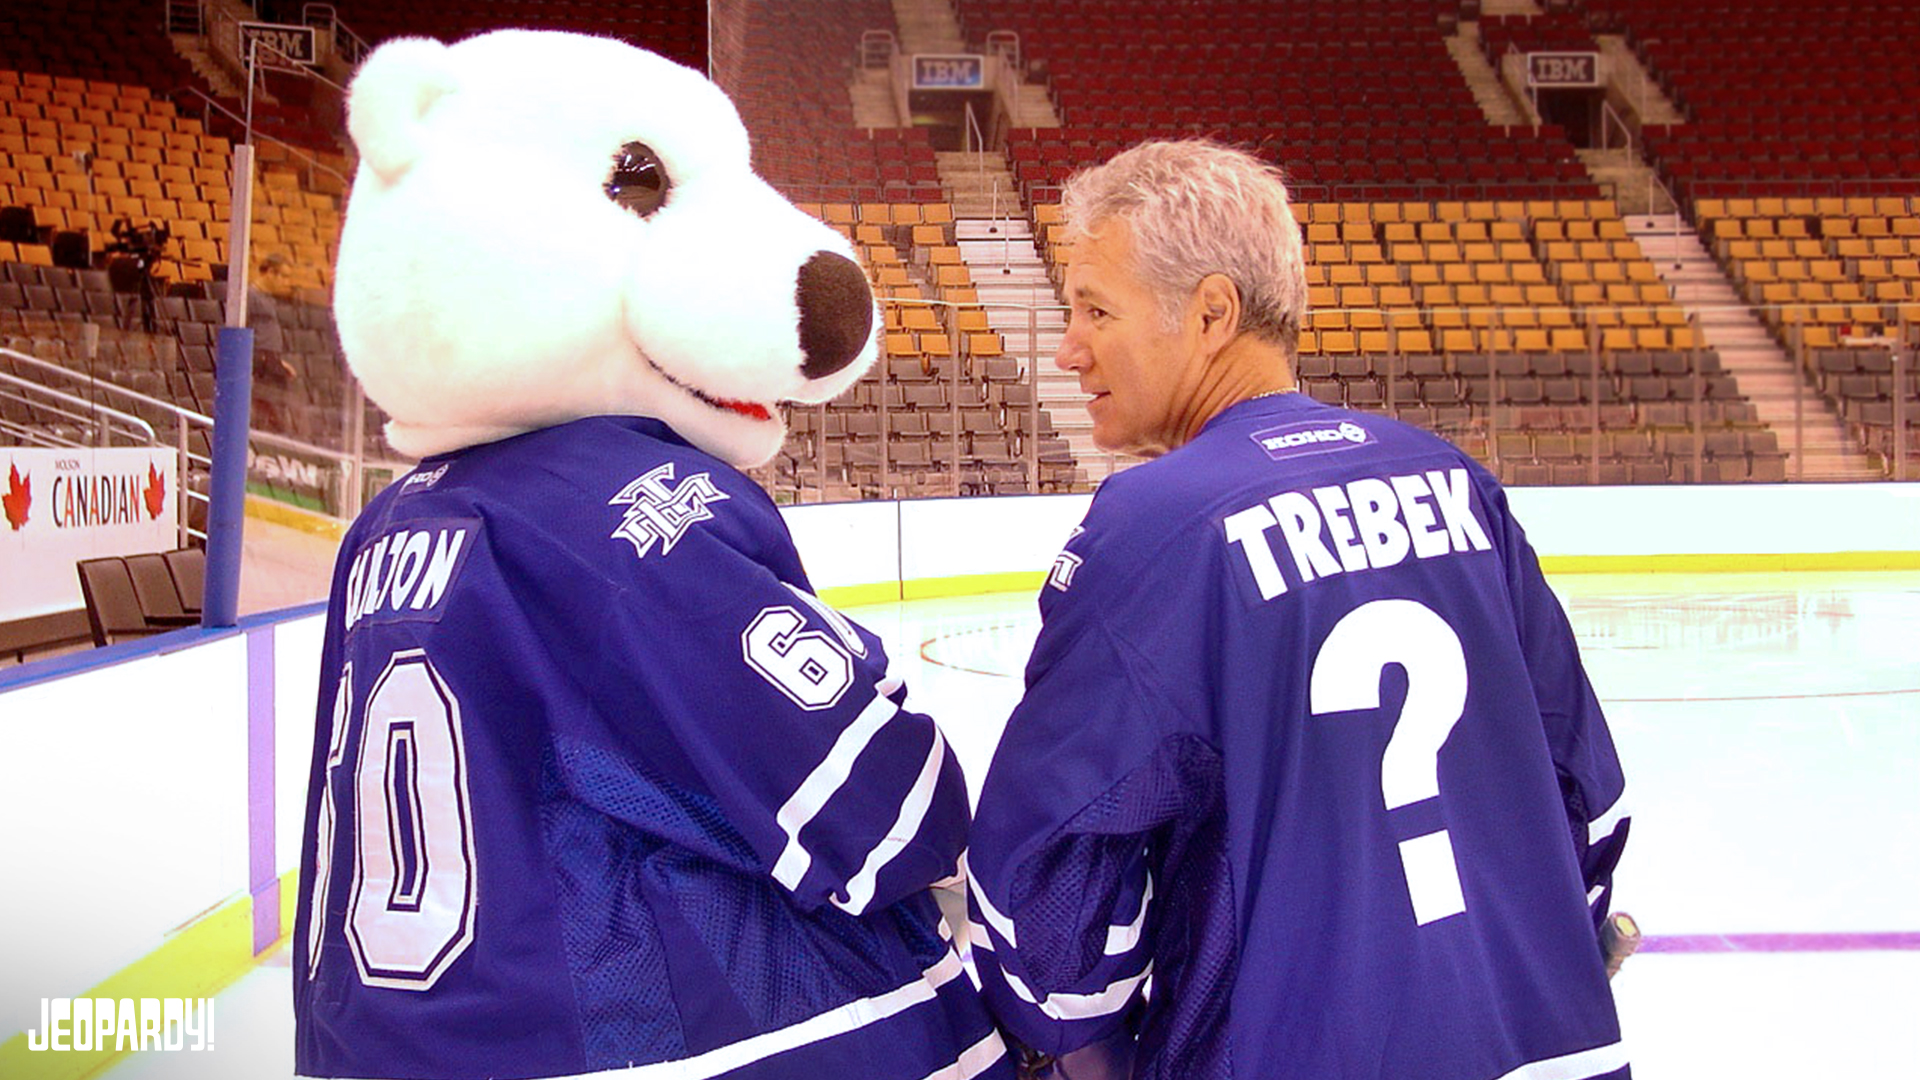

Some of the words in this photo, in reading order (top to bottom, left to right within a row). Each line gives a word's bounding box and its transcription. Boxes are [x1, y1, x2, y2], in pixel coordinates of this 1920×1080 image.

[922, 61, 973, 84] IBM
[1537, 59, 1587, 80] IBM
[52, 474, 140, 529] CANADIAN
[1223, 468, 1492, 601] TREBEK
[1310, 598, 1468, 926] ?
